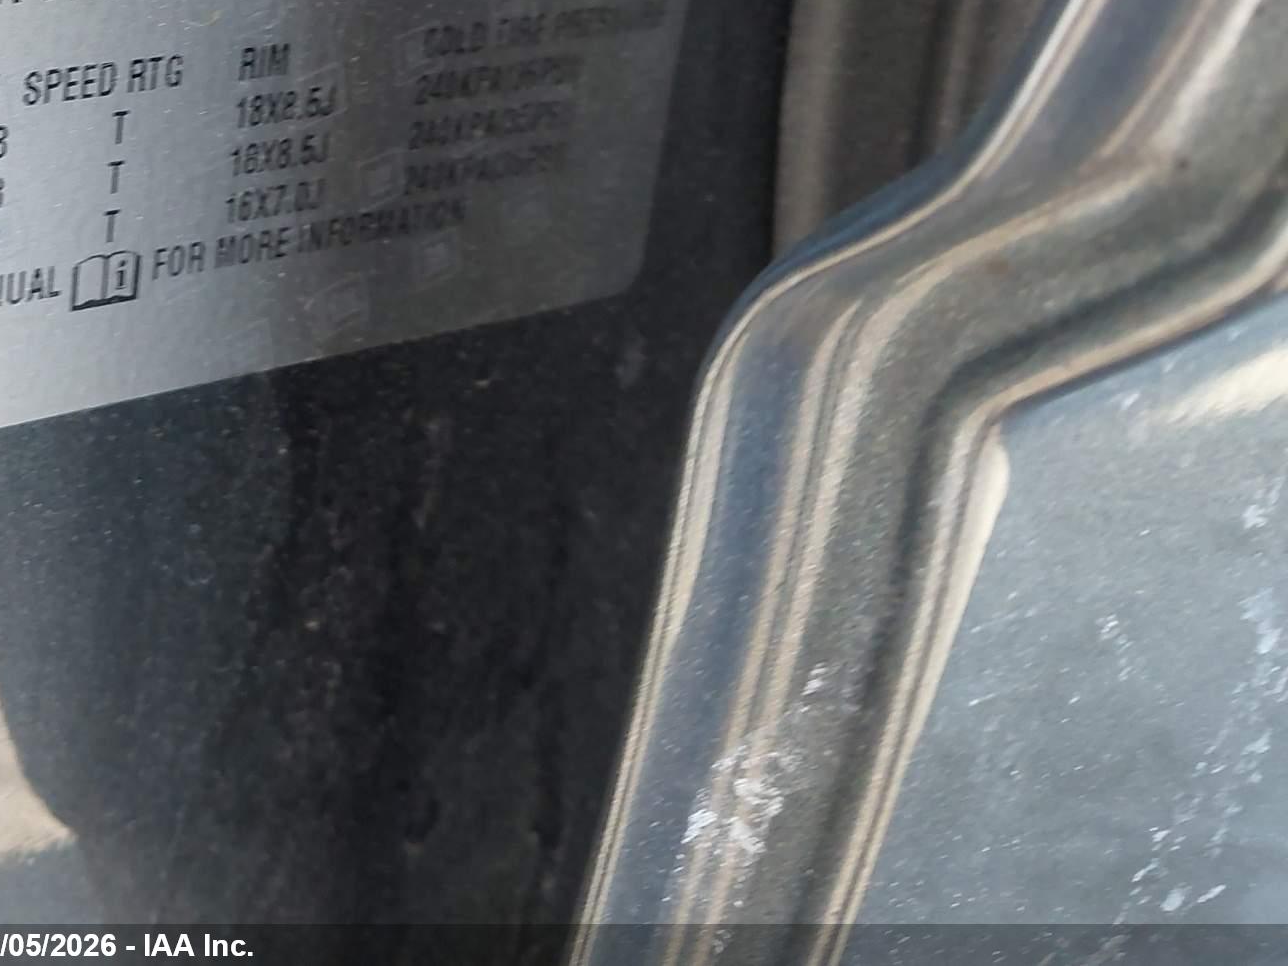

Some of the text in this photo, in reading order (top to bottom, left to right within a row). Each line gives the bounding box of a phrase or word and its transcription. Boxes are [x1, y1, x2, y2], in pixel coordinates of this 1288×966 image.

[238, 43, 291, 81] RIM
[23, 55, 183, 106] SPEED RTG
[112, 110, 130, 144] T
[108, 161, 125, 194] T
[103, 210, 121, 243] T
[152, 199, 467, 280] FOR MORE INFORMATION
